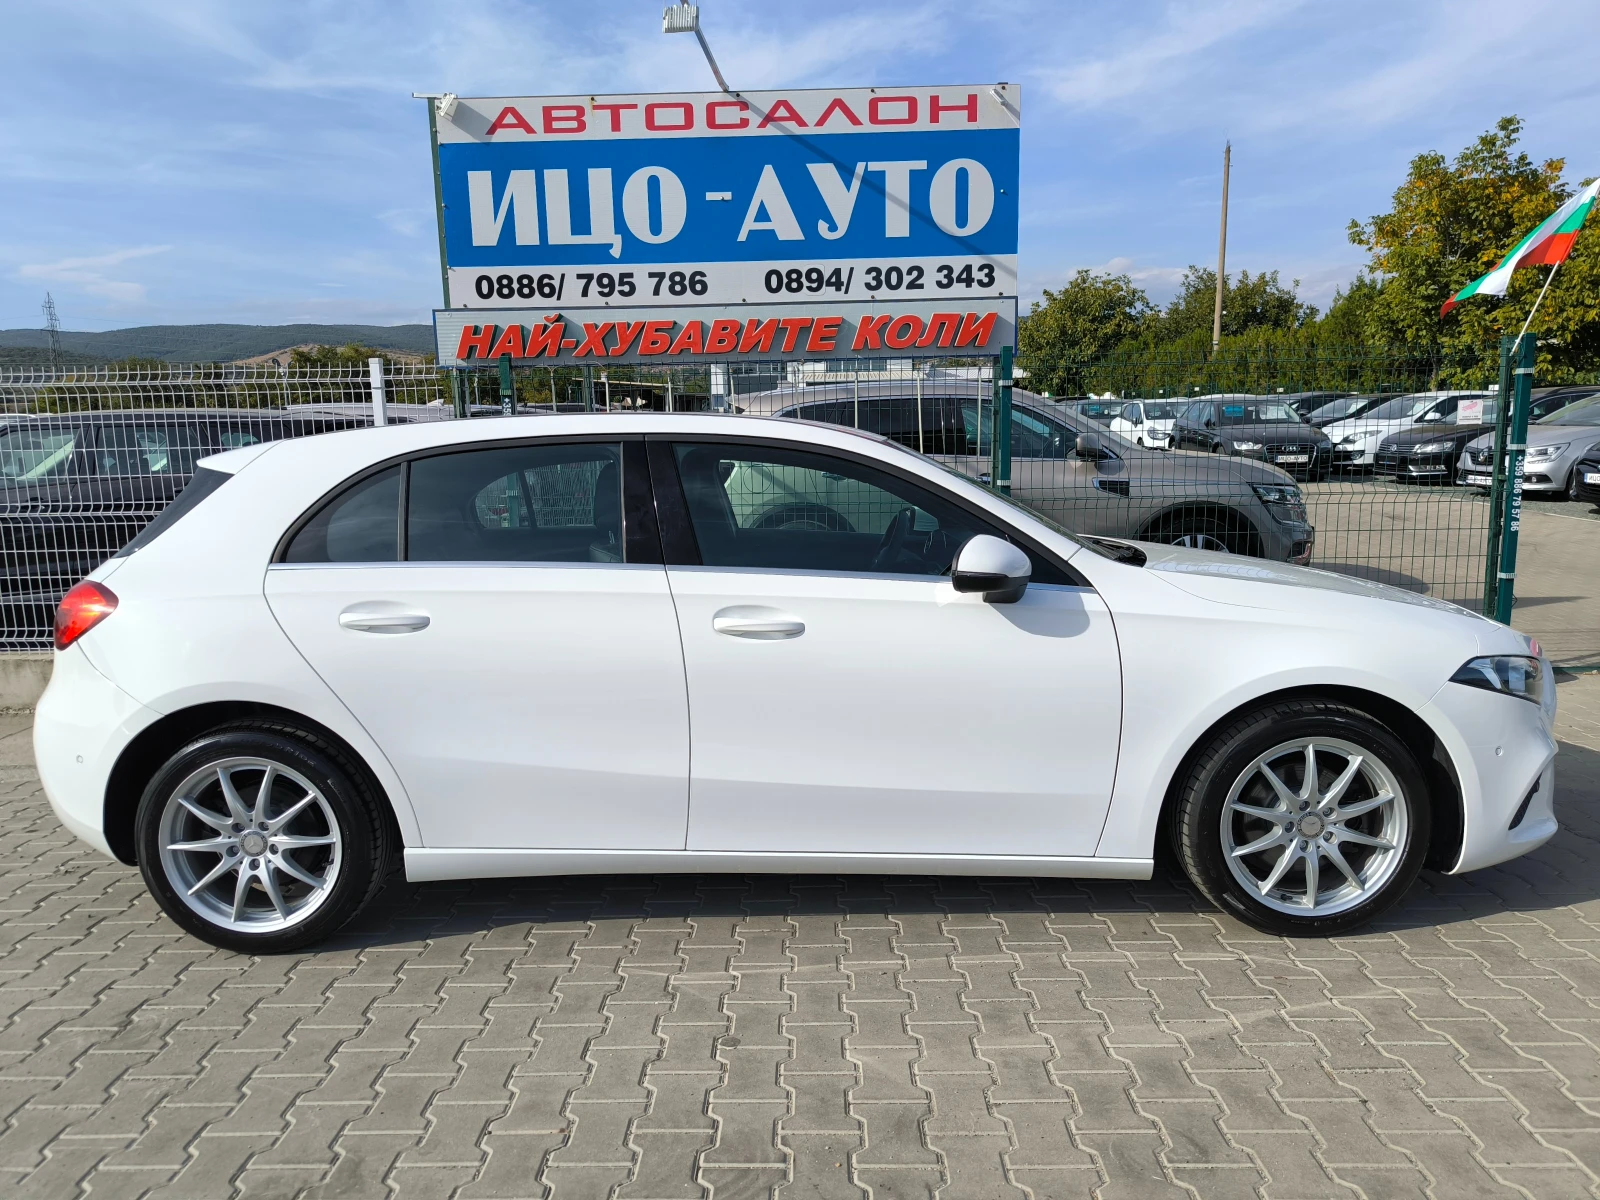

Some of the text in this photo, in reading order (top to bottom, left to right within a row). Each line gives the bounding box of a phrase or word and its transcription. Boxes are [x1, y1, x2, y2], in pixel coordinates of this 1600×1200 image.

[486, 94, 979, 135] АВТОСАЛОН
[475, 271, 709, 300] 0886/ 795 786
[764, 263, 996, 294] 0894/ 302 343
[456, 312, 998, 359] НАЙ-ХУБАВИТЕ КОЛИ
[1510, 455, 1524, 532] +359 886 79 57 86
